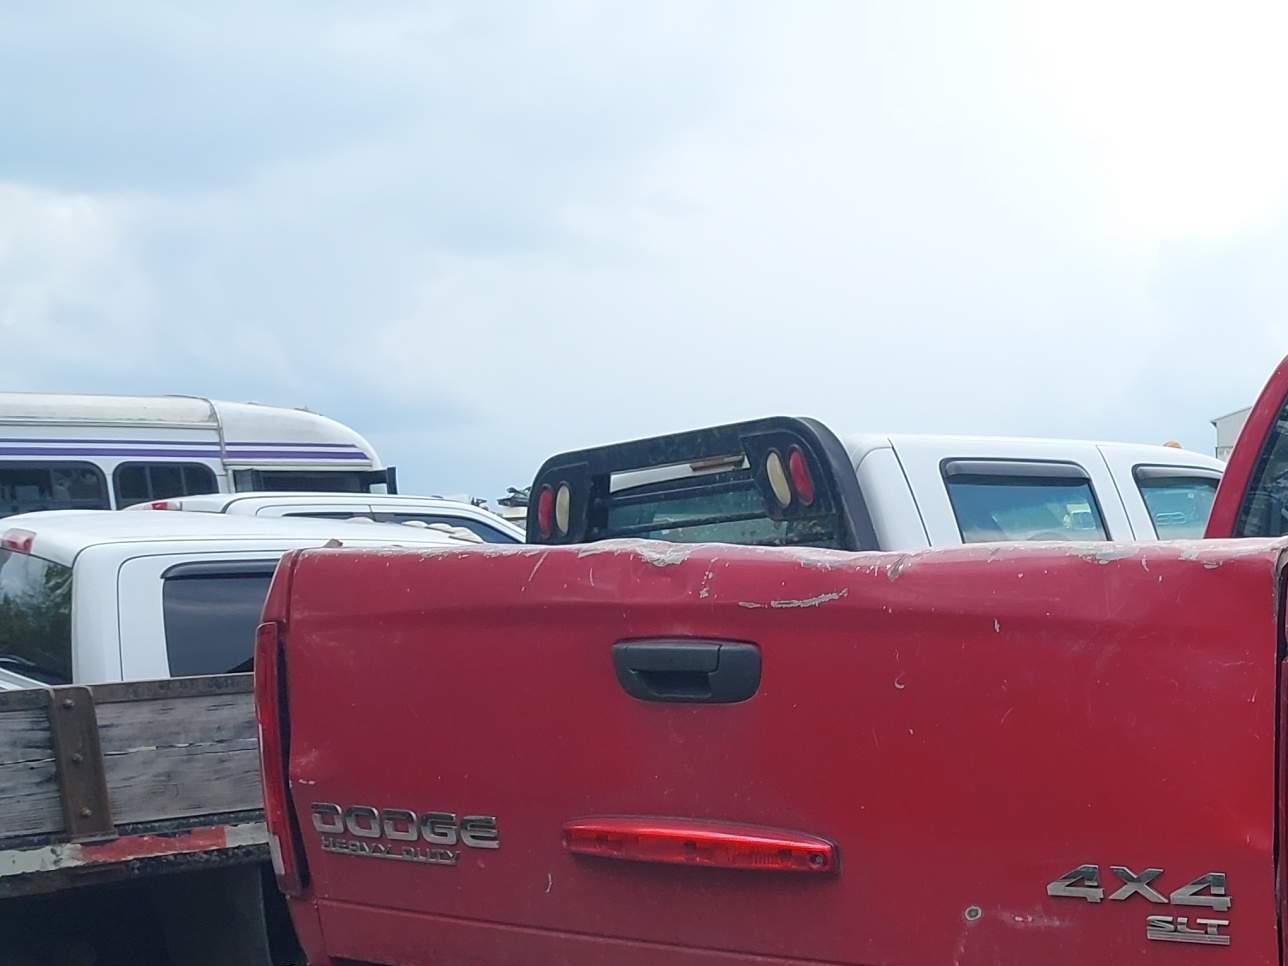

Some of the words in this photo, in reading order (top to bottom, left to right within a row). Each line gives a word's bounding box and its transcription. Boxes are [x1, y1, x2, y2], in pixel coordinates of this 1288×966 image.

[311, 802, 500, 849] DODGE
[321, 836, 392, 857] HEAVY
[402, 846, 461, 865] DUTY
[1046, 864, 1231, 912] 4X4
[1146, 915, 1230, 936] SLT
